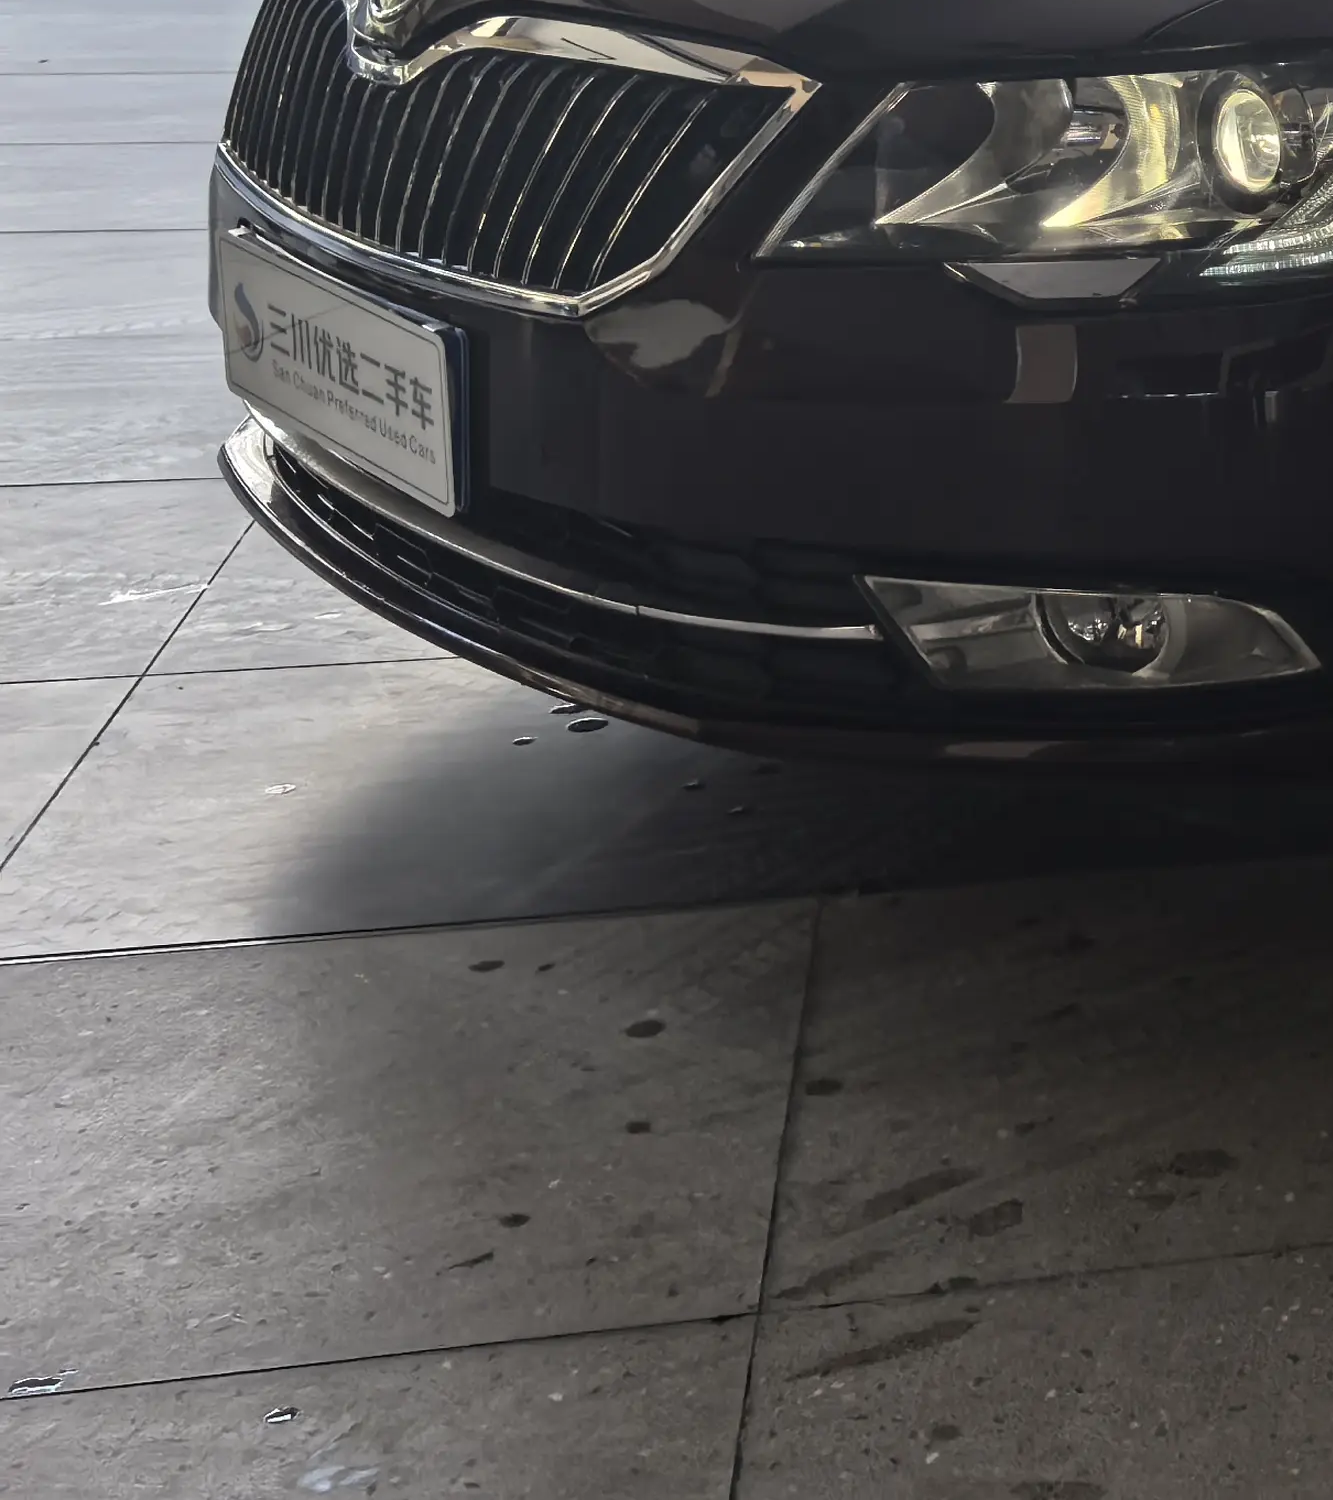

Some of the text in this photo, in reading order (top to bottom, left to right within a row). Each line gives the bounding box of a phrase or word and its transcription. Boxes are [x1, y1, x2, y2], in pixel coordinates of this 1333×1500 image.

[267, 303, 436, 431] 三川优选二手车
[272, 358, 292, 386] San
[378, 418, 409, 452] Used
[408, 434, 437, 466] Cars
